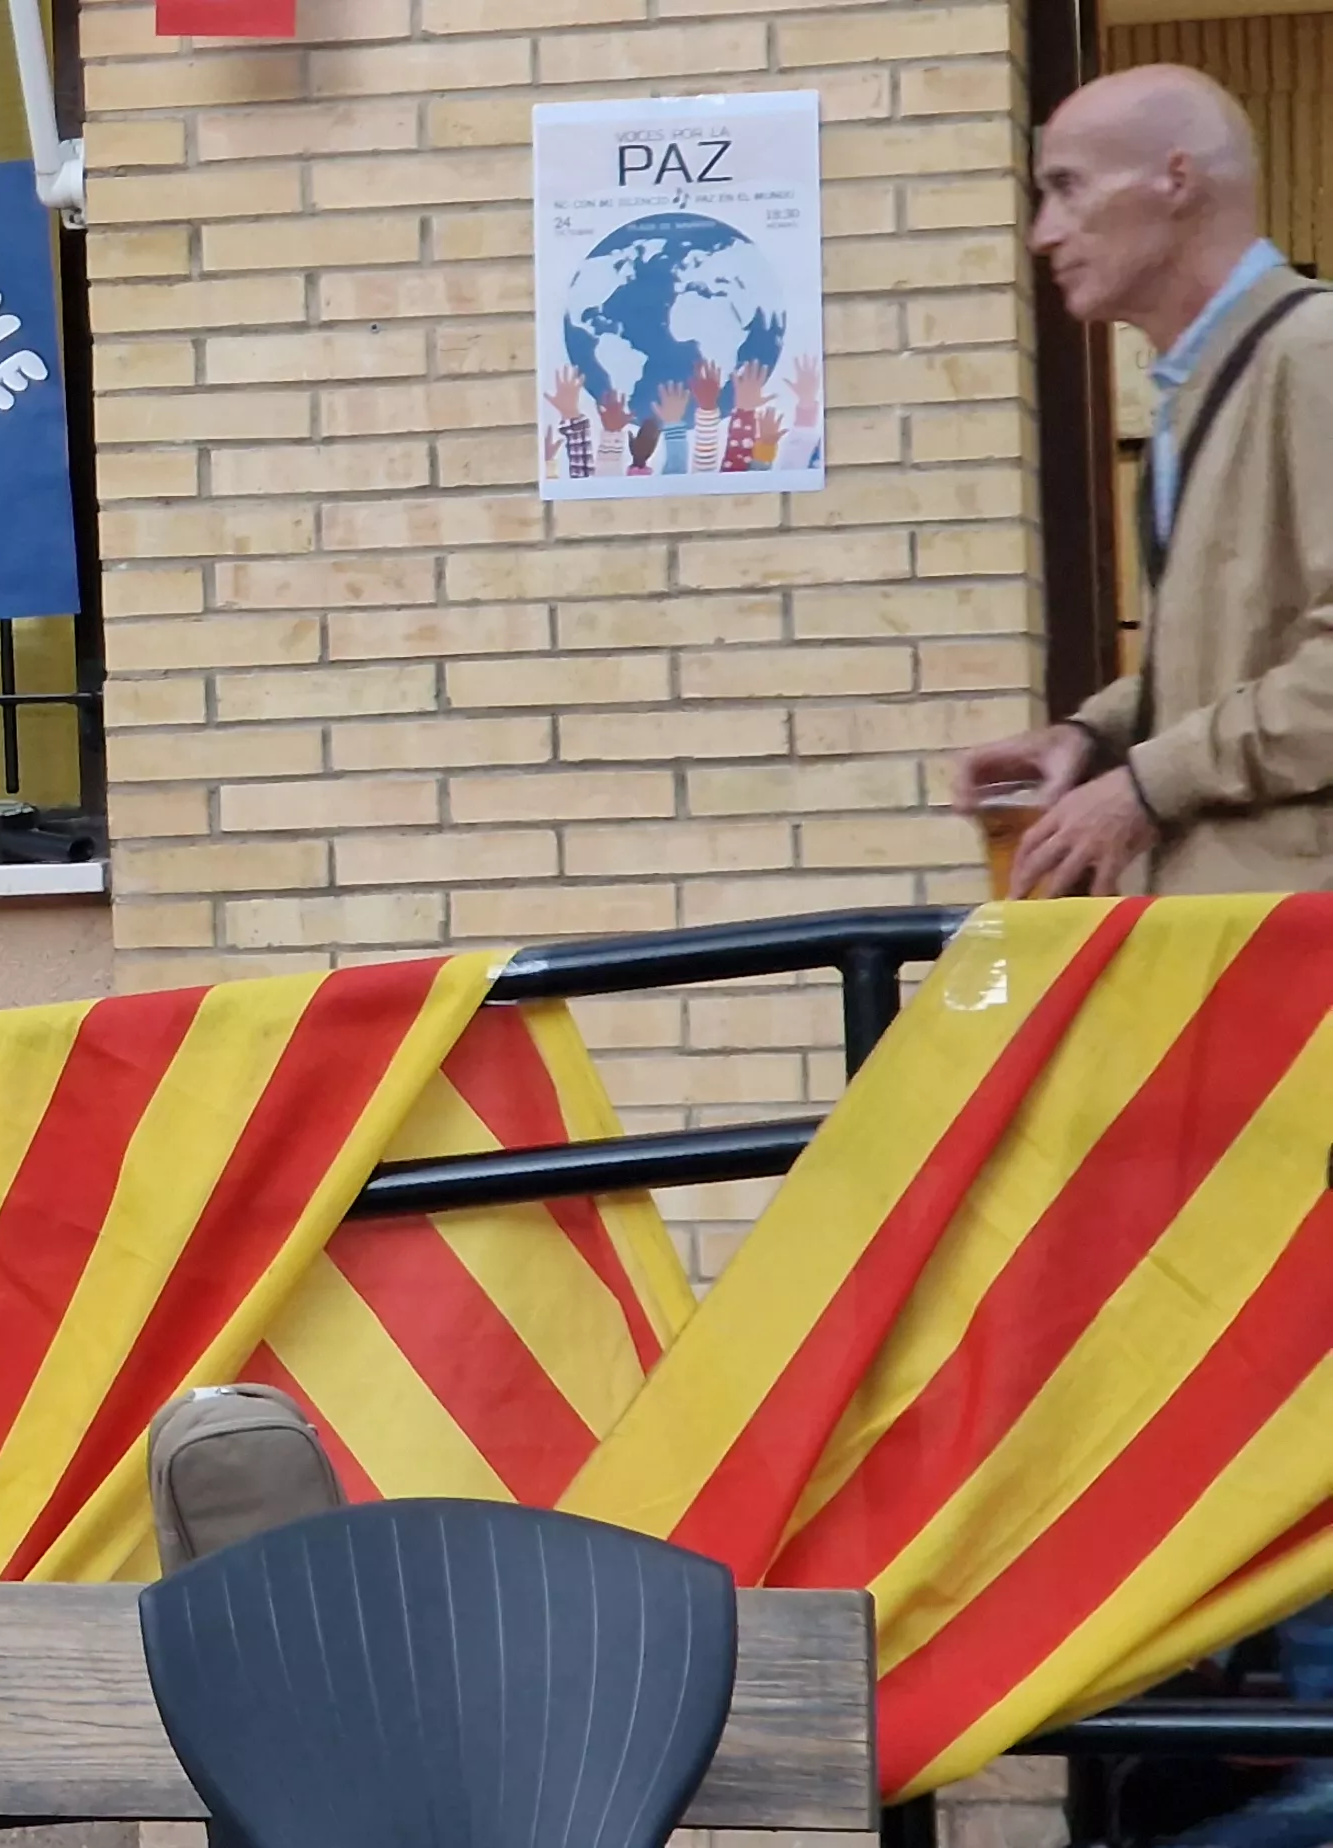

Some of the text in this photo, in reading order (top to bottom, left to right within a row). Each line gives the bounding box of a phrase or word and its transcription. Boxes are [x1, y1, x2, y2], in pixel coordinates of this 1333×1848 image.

[673, 127, 703, 140] POR
[711, 125, 731, 138] LA
[618, 140, 733, 187] PAZ
[554, 216, 571, 229] 24
